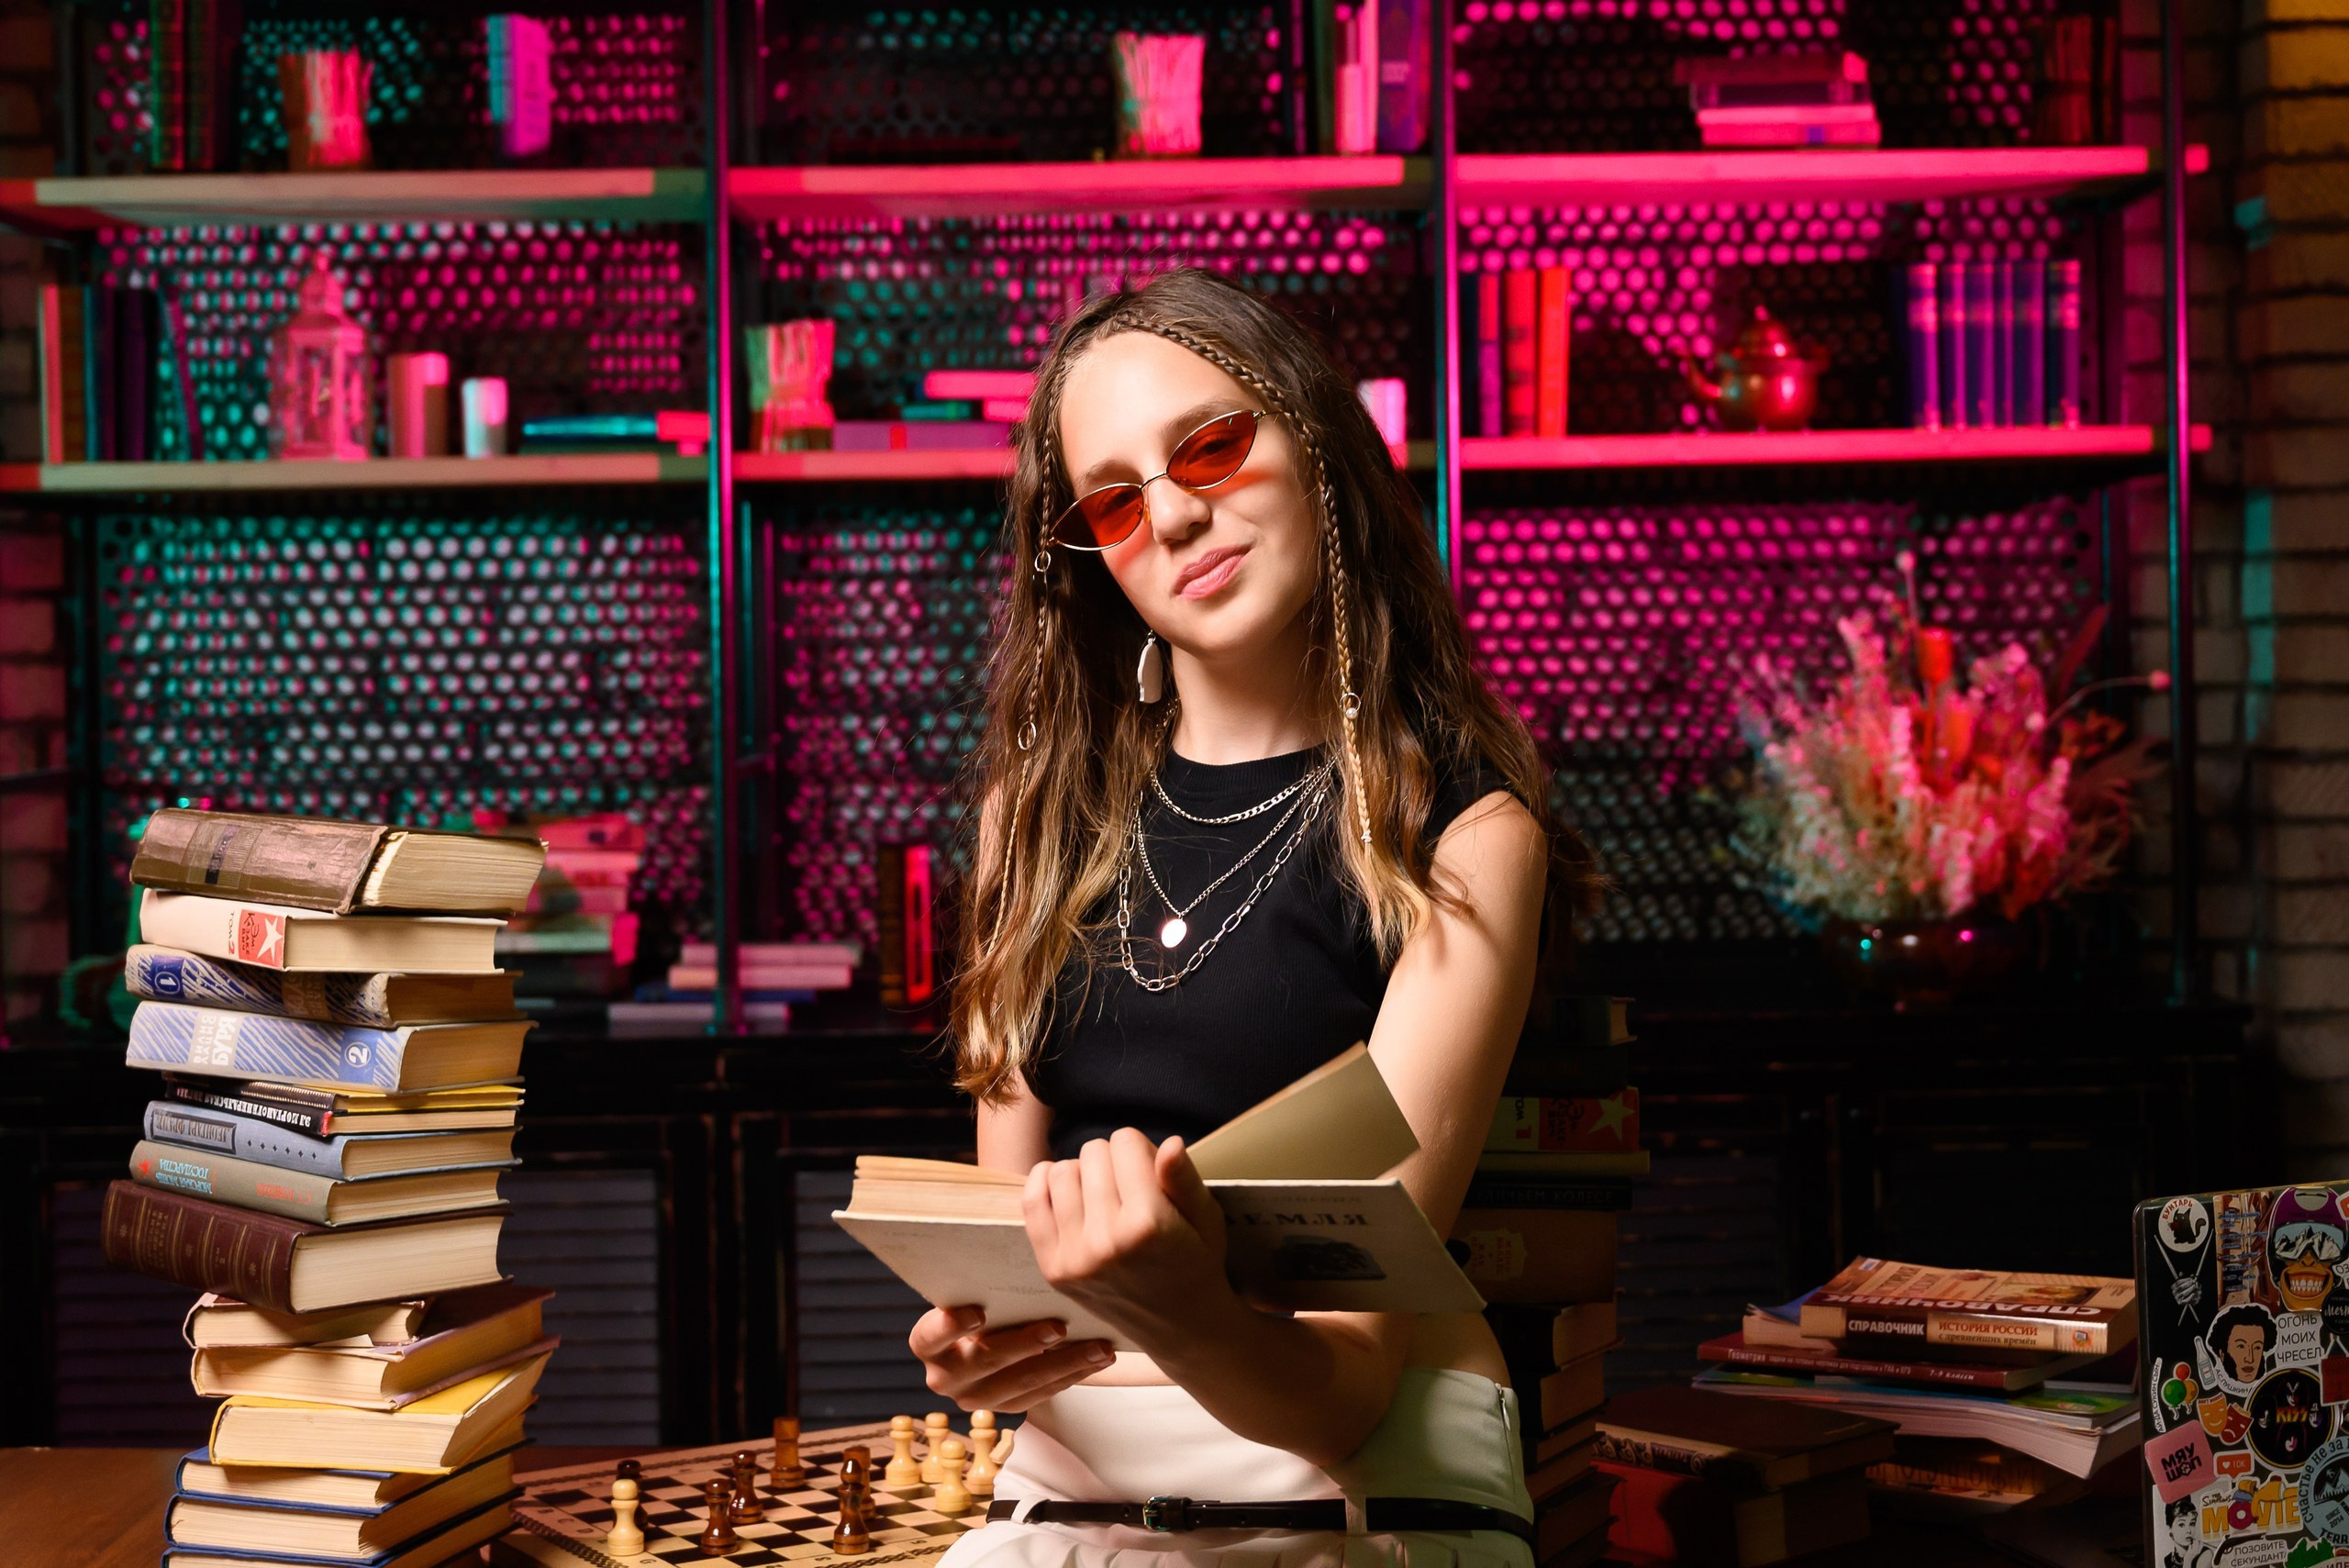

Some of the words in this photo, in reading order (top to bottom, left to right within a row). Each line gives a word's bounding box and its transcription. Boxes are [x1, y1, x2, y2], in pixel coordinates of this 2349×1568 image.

[228, 941, 235, 955] 2
[211, 1017, 237, 1066] БУРЯ
[349, 1044, 371, 1065] 2
[160, 1158, 209, 1180] ГОСУДАРСТВА
[1554, 1189, 1615, 1204] КОЛЕСЕ
[2162, 1198, 2193, 1219] БУНТАРЬ
[1826, 1293, 2102, 1317] СПРАВОЧНИК
[1847, 1318, 1926, 1337] СПРАВОЧНИК
[1938, 1322, 1990, 1335] ИСТОРИЯ
[1992, 1324, 2039, 1337] РОССИИ
[2277, 1315, 2318, 1329] ОГОНЬ
[2280, 1330, 2316, 1346] МОИХ
[1727, 1349, 1766, 1363] Геометрия
[2277, 1346, 2321, 1363] ЧРЕСЕЛ
[2152, 1364, 2160, 1382] СЫН
[2276, 1406, 2309, 1424] KISS
[2161, 1442, 2195, 1471] МЯУ
[2311, 1448, 2328, 1465] не
[2328, 1439, 2343, 1453] за
[2232, 1460, 2246, 1468] 10K
[2202, 1486, 2300, 1534] MOVIE
[2325, 1507, 2341, 1521] SINCE
[2329, 1515, 2344, 1529] 2014
[2233, 1540, 2285, 1555] ПОЗОВИТЕ
